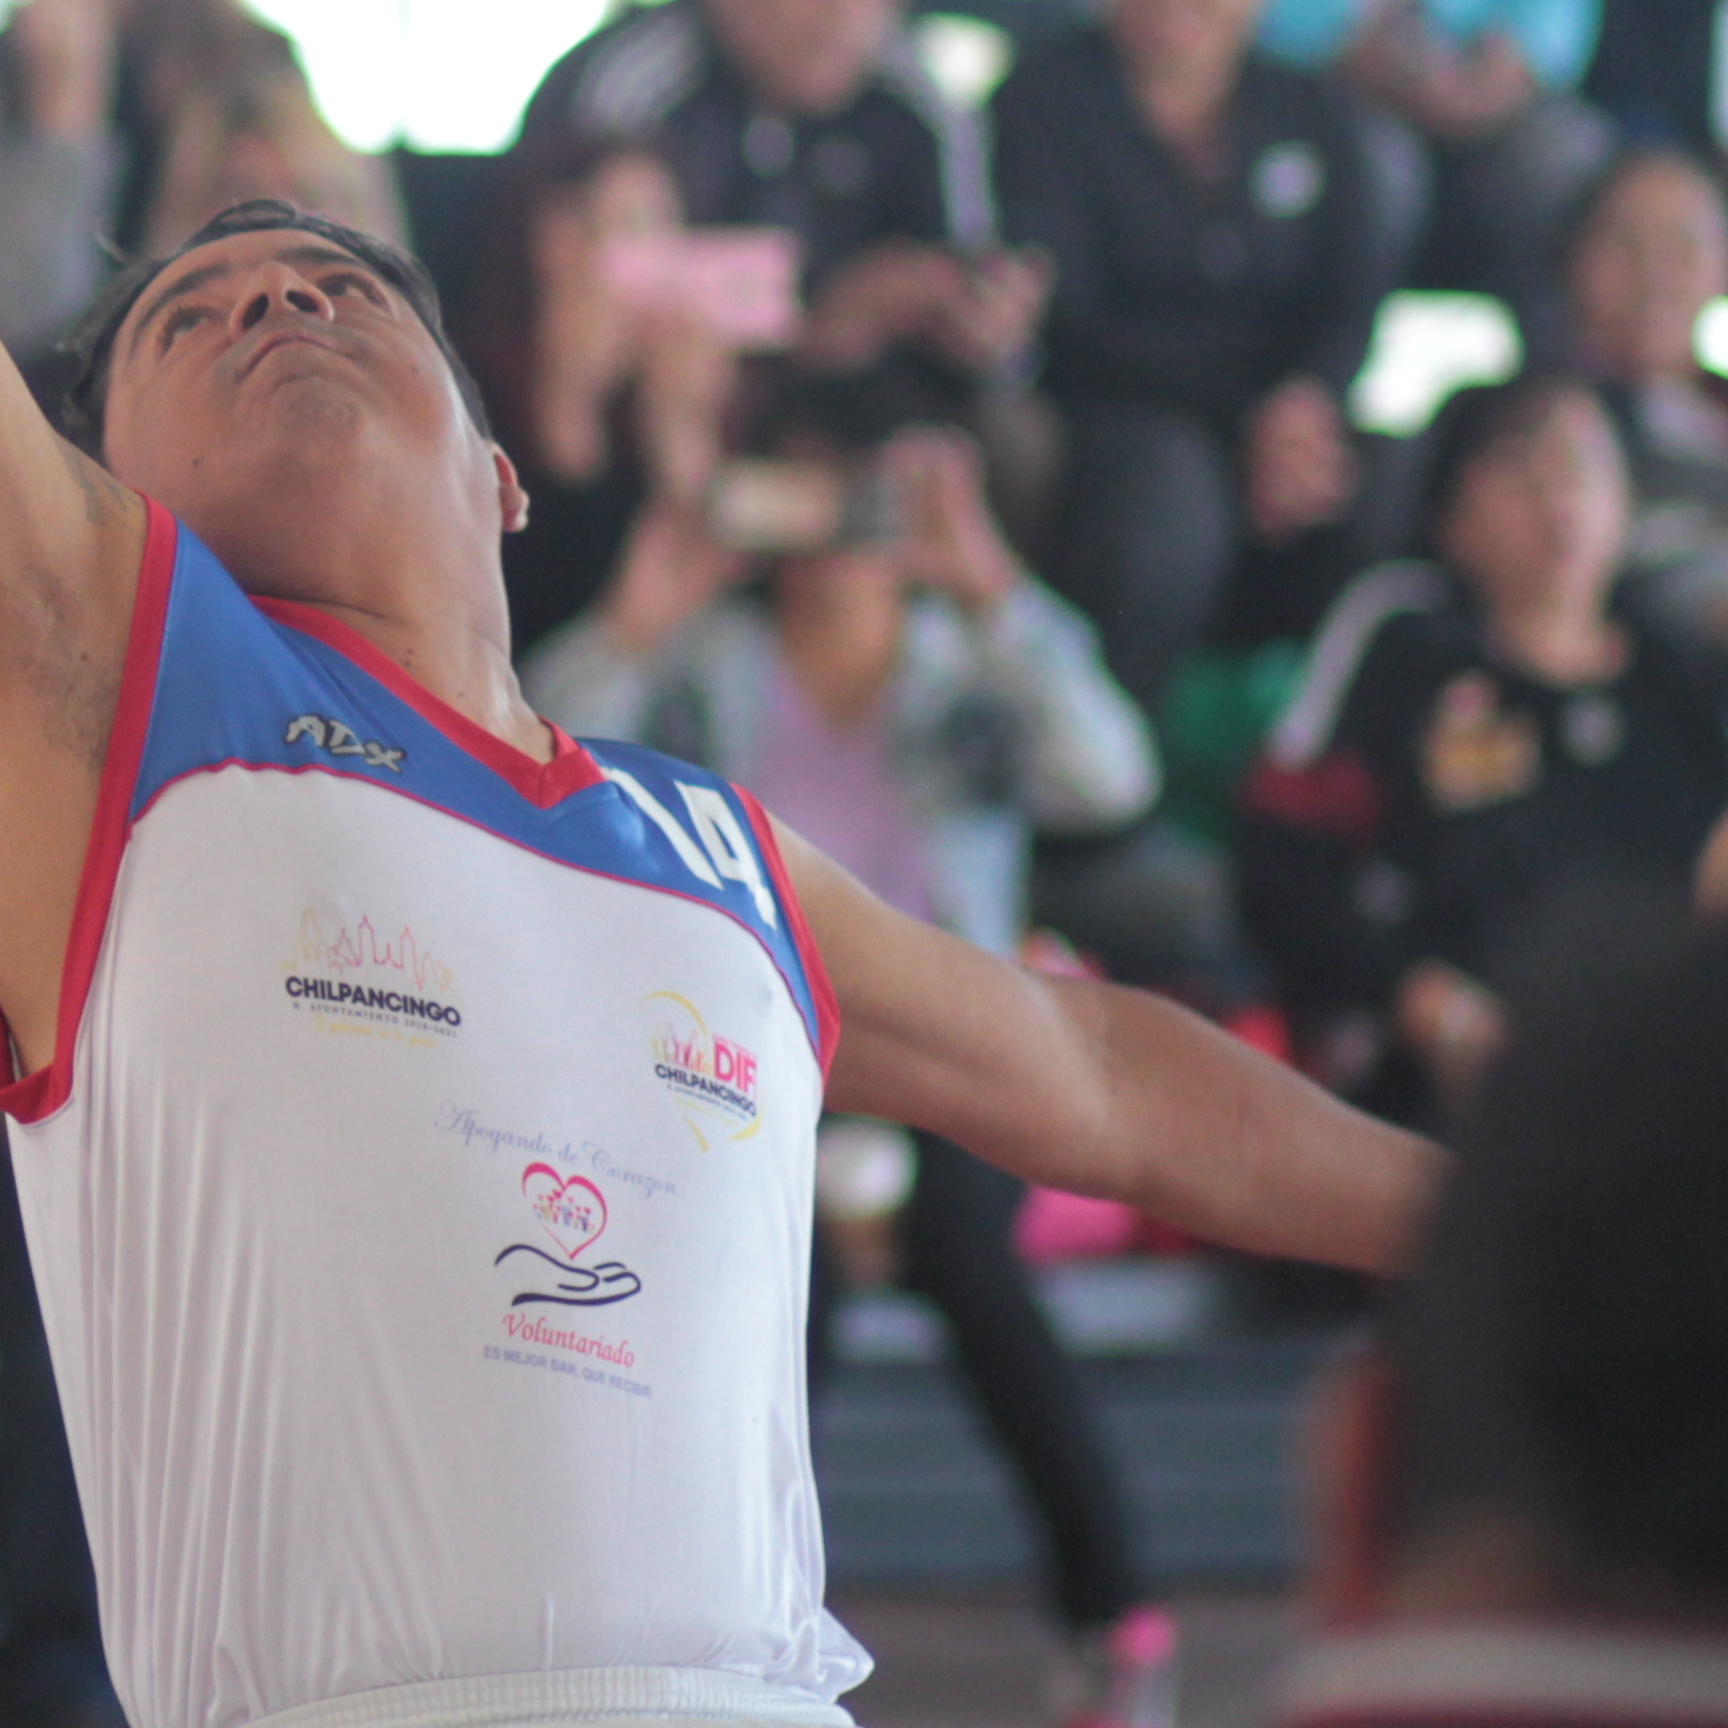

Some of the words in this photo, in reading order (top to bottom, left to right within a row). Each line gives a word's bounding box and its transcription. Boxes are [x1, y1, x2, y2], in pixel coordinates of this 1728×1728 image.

[602, 766, 777, 929] 14
[285, 976, 461, 1026] CHILPANCINGO
[654, 1062, 757, 1118] CHILPANCINGO
[714, 1039, 756, 1094] DIF
[434, 1101, 552, 1152] Apoyando
[483, 1345, 501, 1361] ES
[503, 1349, 549, 1369] MEJOR
[582, 1367, 606, 1385] QUE
[502, 1312, 636, 1369] Voluntariado
